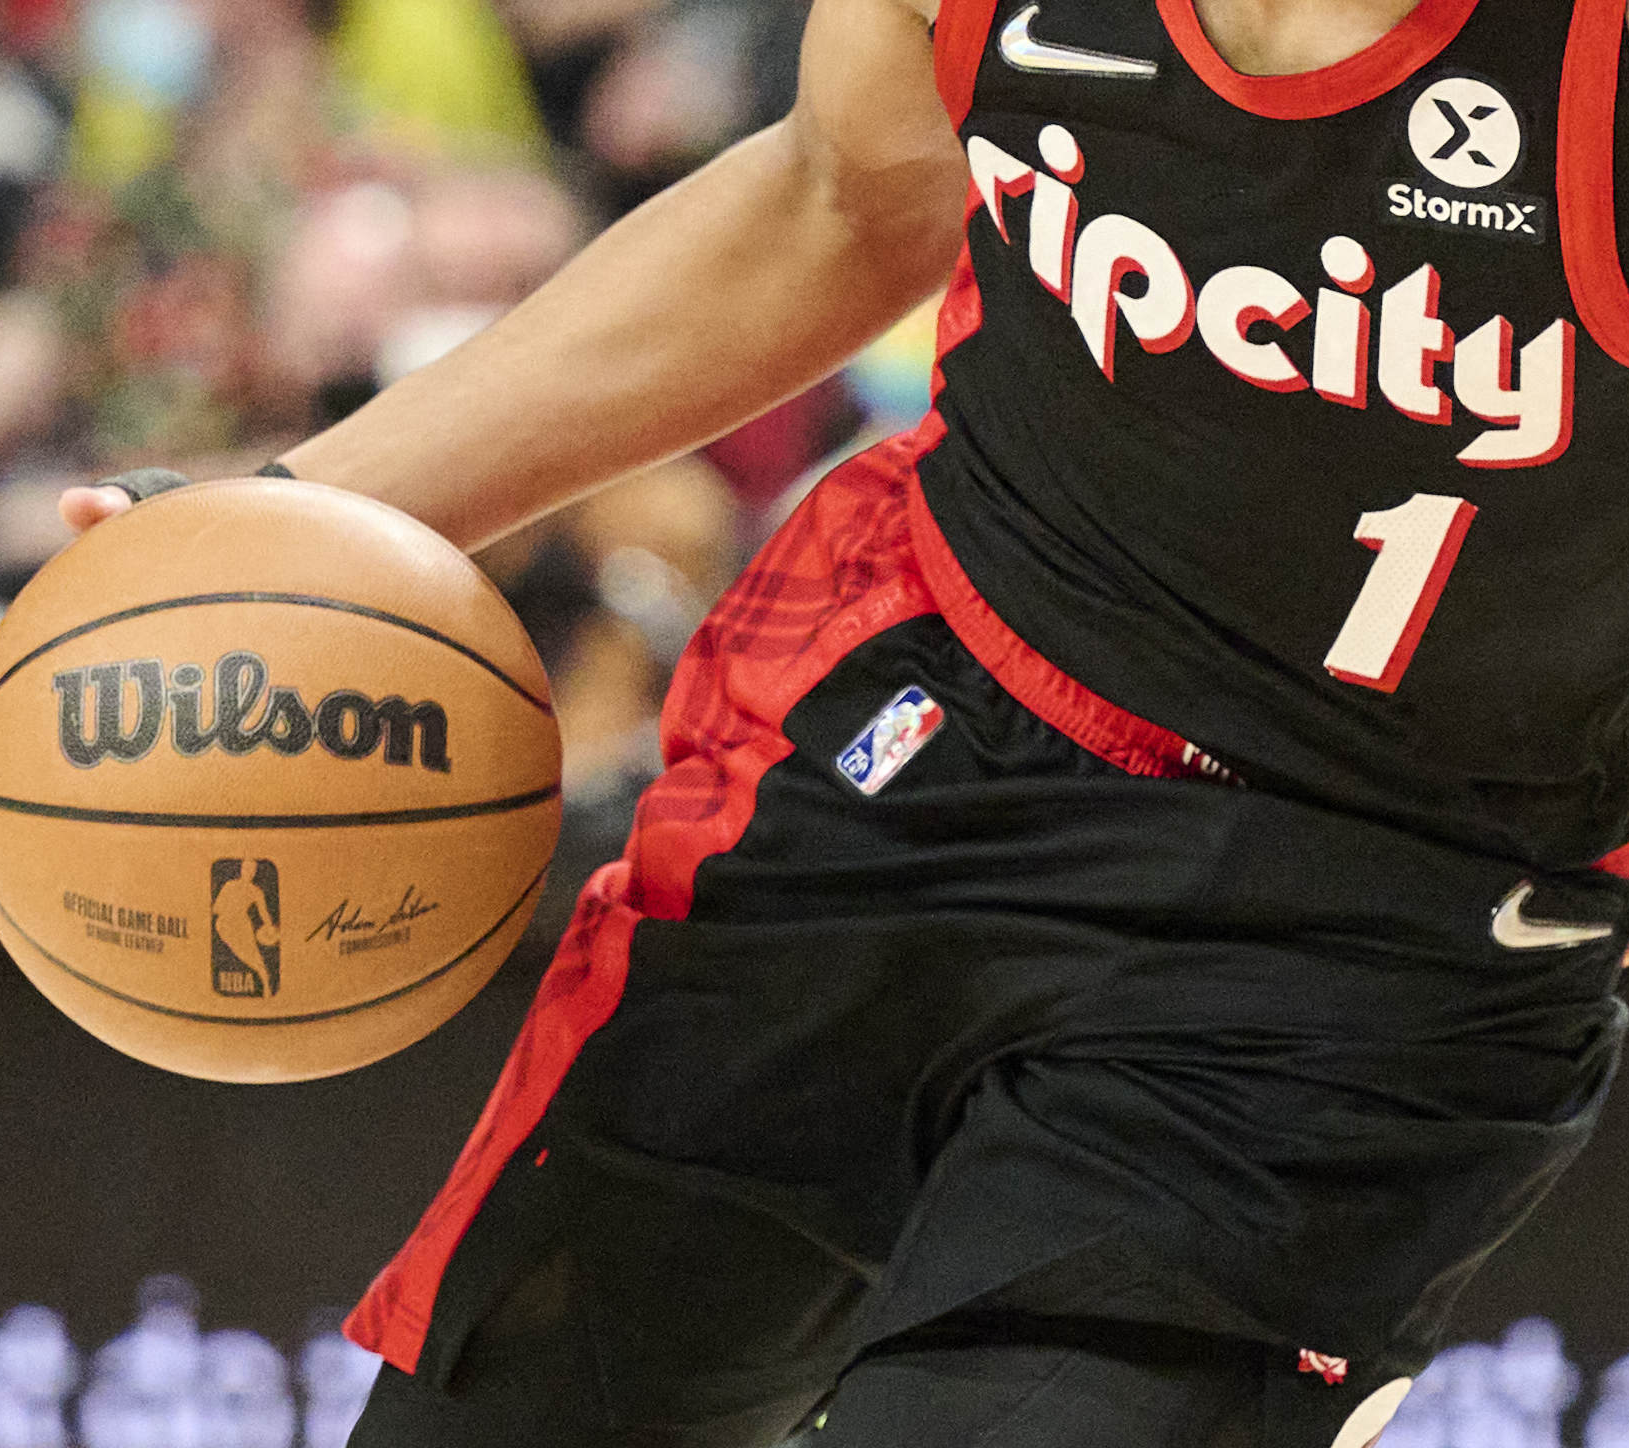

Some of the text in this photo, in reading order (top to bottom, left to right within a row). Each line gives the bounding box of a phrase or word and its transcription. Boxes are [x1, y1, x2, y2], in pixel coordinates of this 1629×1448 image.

[1387, 183, 1537, 234] StormX
[966, 123, 1576, 470] ripcity
[1323, 492, 1478, 694] 1
[52, 651, 452, 773] Wilson
